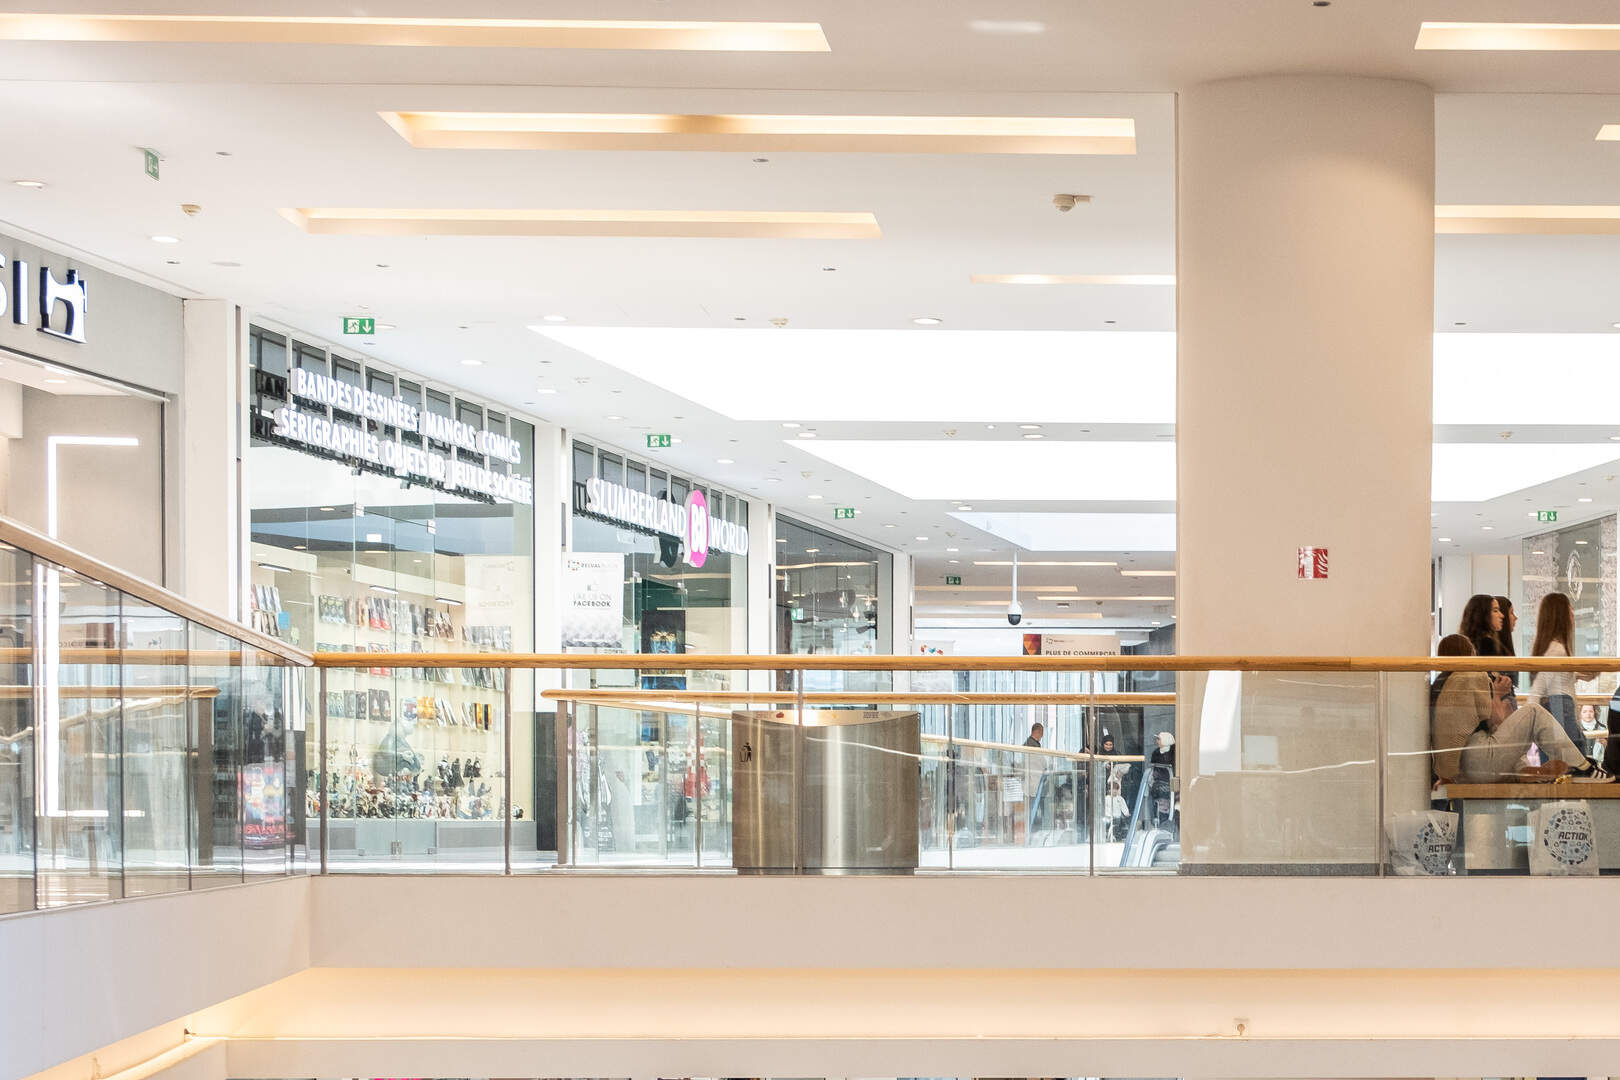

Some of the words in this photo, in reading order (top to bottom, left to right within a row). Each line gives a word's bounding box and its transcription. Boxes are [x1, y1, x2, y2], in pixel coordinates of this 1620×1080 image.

[273, 402, 379, 461] SÉRIGRAPHIES
[380, 440, 427, 477] OBJETS
[428, 452, 445, 480] BD
[446, 459, 476, 491] JEUX
[476, 467, 491, 491] DE
[291, 367, 351, 408] BANDES
[352, 387, 418, 432] DESSINÉES
[420, 411, 476, 450] MANGAS
[476, 430, 522, 464] COMICS
[586, 477, 687, 537] SLUMBERLAND
[690, 504, 707, 553] BD
[708, 516, 749, 556] WORLD
[573, 600, 612, 608] FACEBOOK
[1558, 831, 1589, 841] ACTION
